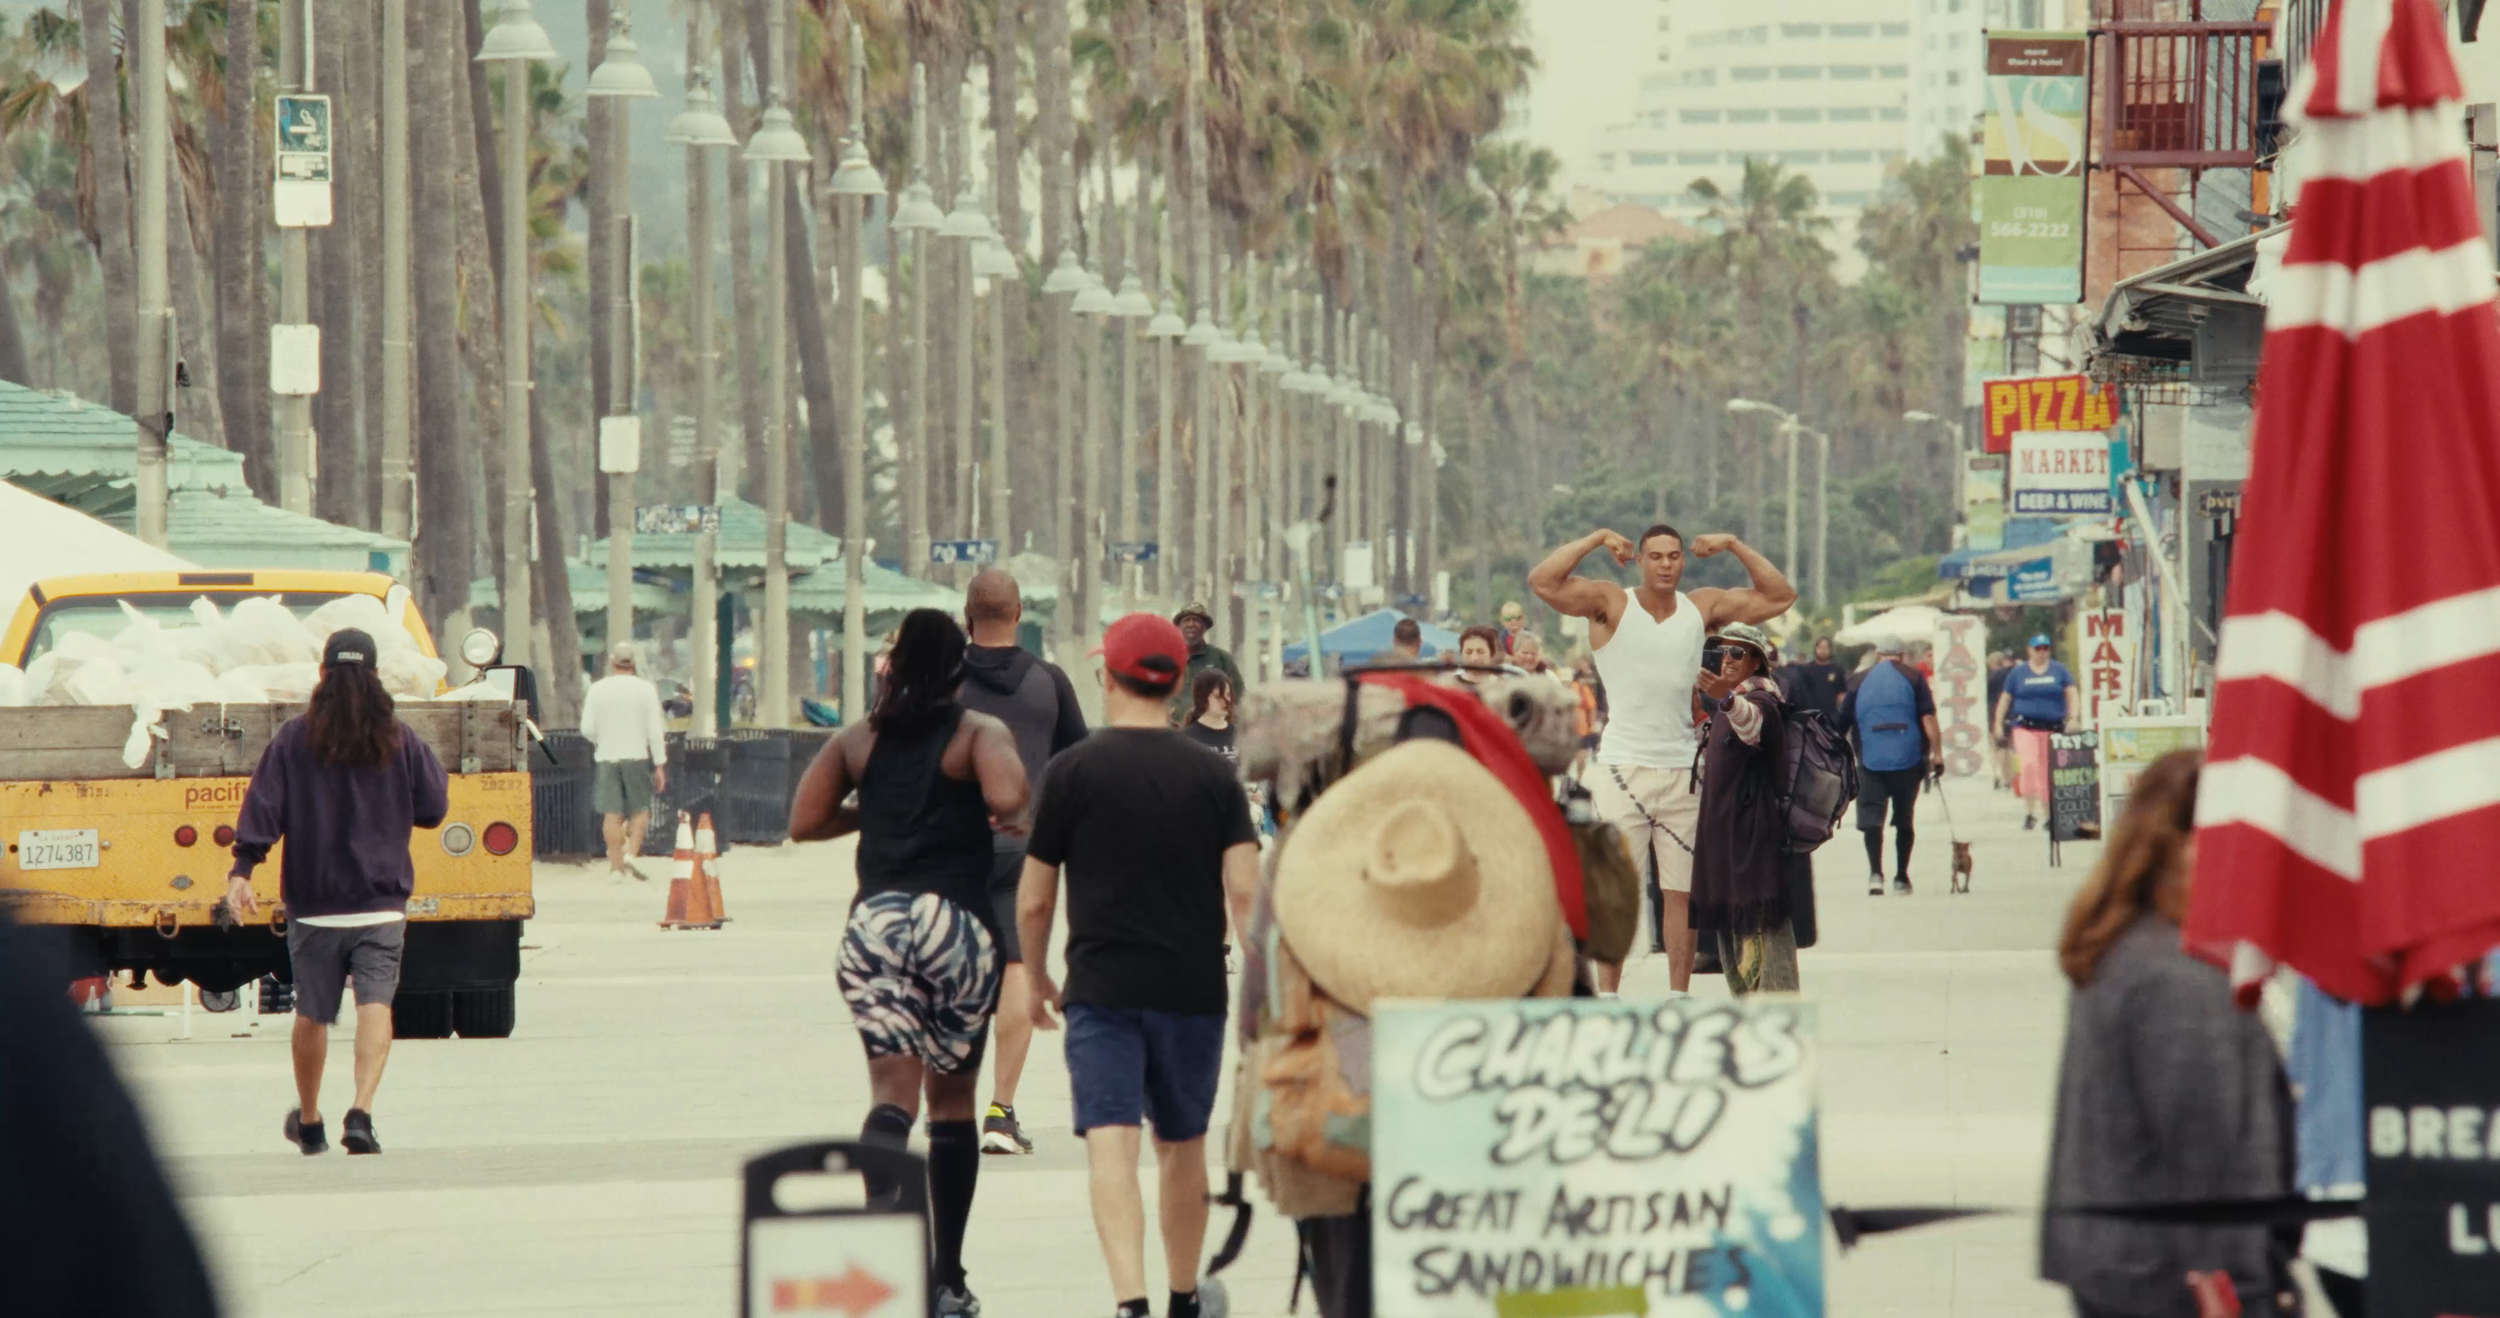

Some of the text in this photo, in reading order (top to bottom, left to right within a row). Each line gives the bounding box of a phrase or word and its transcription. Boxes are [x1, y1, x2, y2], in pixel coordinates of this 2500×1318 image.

[2007, 57, 2029, 66] than
[2039, 57, 2063, 66] hotel
[1989, 379, 2111, 436] PIZZA
[2020, 448, 2108, 474] MARKET
[2018, 493, 2110, 509] BEER & WINE
[1939, 619, 1984, 777] TATTOO
[2086, 615, 2123, 733] MAR
[25, 844, 93, 865] 1274387
[1490, 1082, 1730, 1167] DELI
[1386, 1175, 1733, 1240] GREAT ARTISAN
